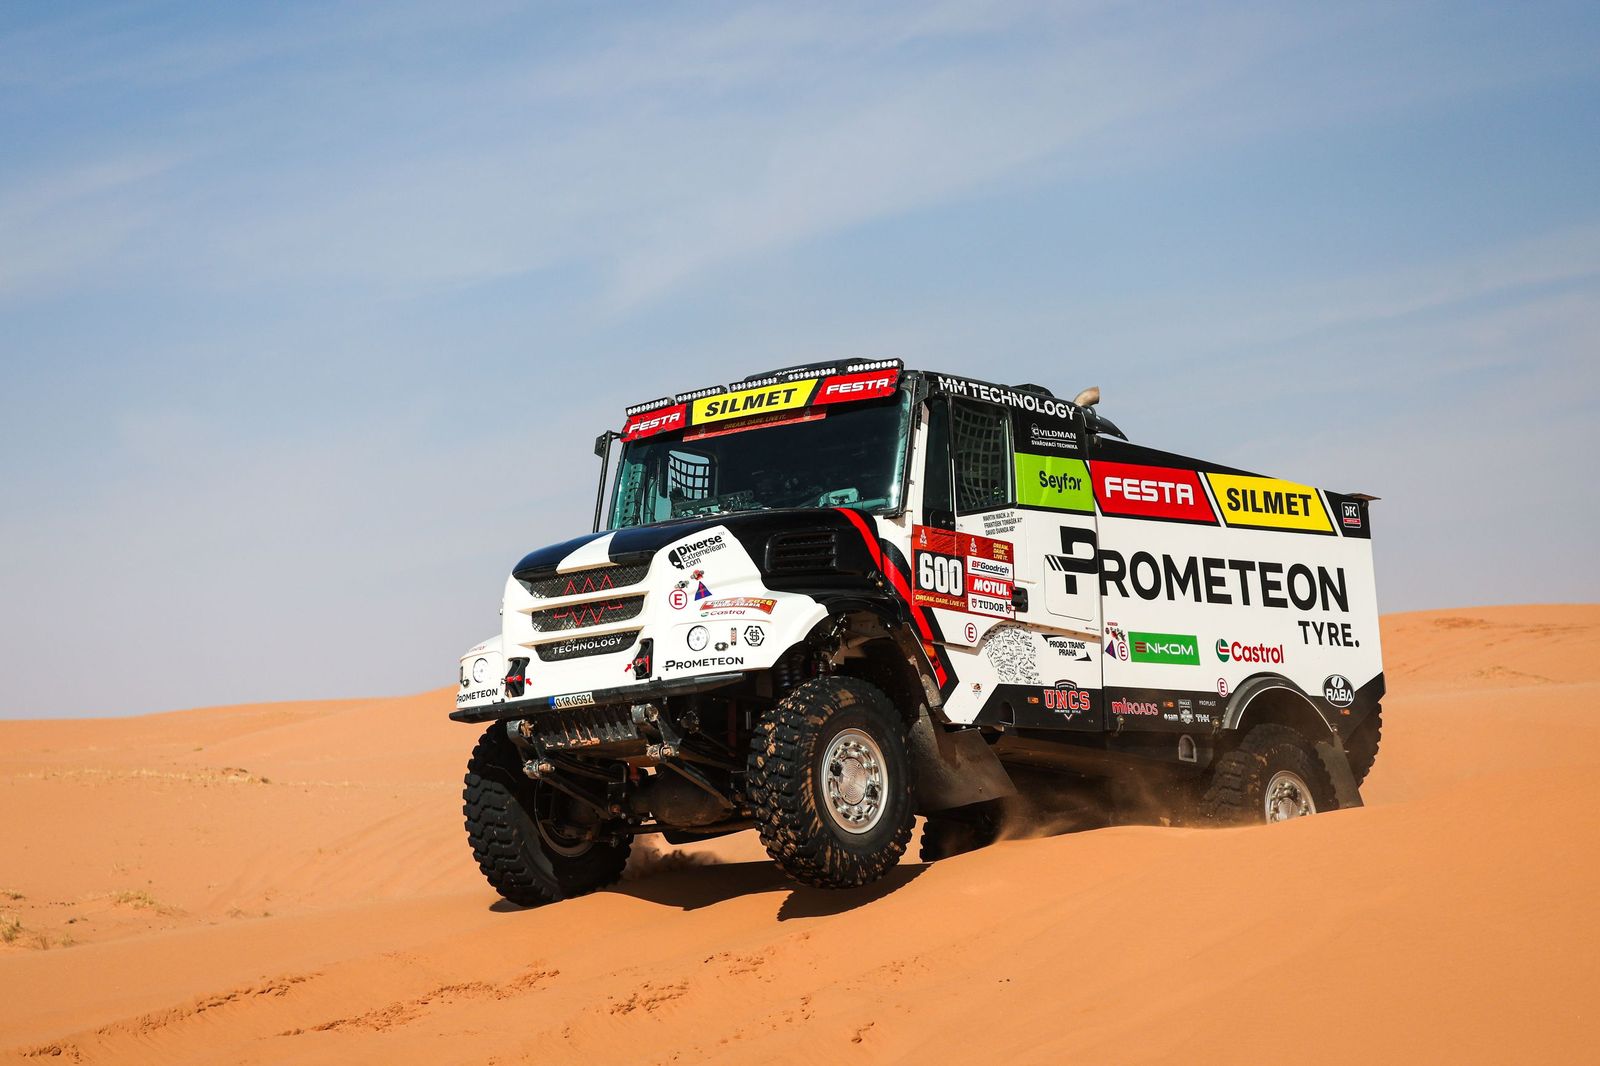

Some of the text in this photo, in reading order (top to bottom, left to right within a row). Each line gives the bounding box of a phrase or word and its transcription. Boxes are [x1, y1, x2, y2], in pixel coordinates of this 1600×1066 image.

[825, 377, 889, 395] FESTA
[705, 388, 797, 417] SILMET
[938, 376, 1075, 420] MM TECHNOLOGY
[628, 412, 681, 433] FESTA
[1039, 429, 1077, 439] VILDMAN
[1039, 470, 1082, 493] Seyfor
[1104, 476, 1194, 505] FESTA
[1227, 487, 1312, 517] SILMET
[676, 535, 723, 556] Diverse
[681, 542, 727, 563] ExtremeTeam
[685, 557, 702, 569] .com
[971, 560, 1010, 575] BFGoodrich
[1045, 526, 1350, 613] PROMETEON
[919, 552, 964, 597] 600
[973, 578, 1010, 596] MOTUL
[915, 594, 936, 603] DREAM.
[978, 599, 1005, 612] TUDOR
[1297, 620, 1361, 648] TYRE.
[553, 637, 623, 655] TECHNOLOGY
[1049, 640, 1086, 650] PROBO TRANS
[1058, 649, 1077, 657] PRAHA
[1134, 641, 1194, 656] ENKOM
[1231, 641, 1285, 664] Castrol
[662, 656, 744, 671] PROMETEON
[1043, 689, 1091, 711] UNCS
[1111, 697, 1159, 716] miROADS
